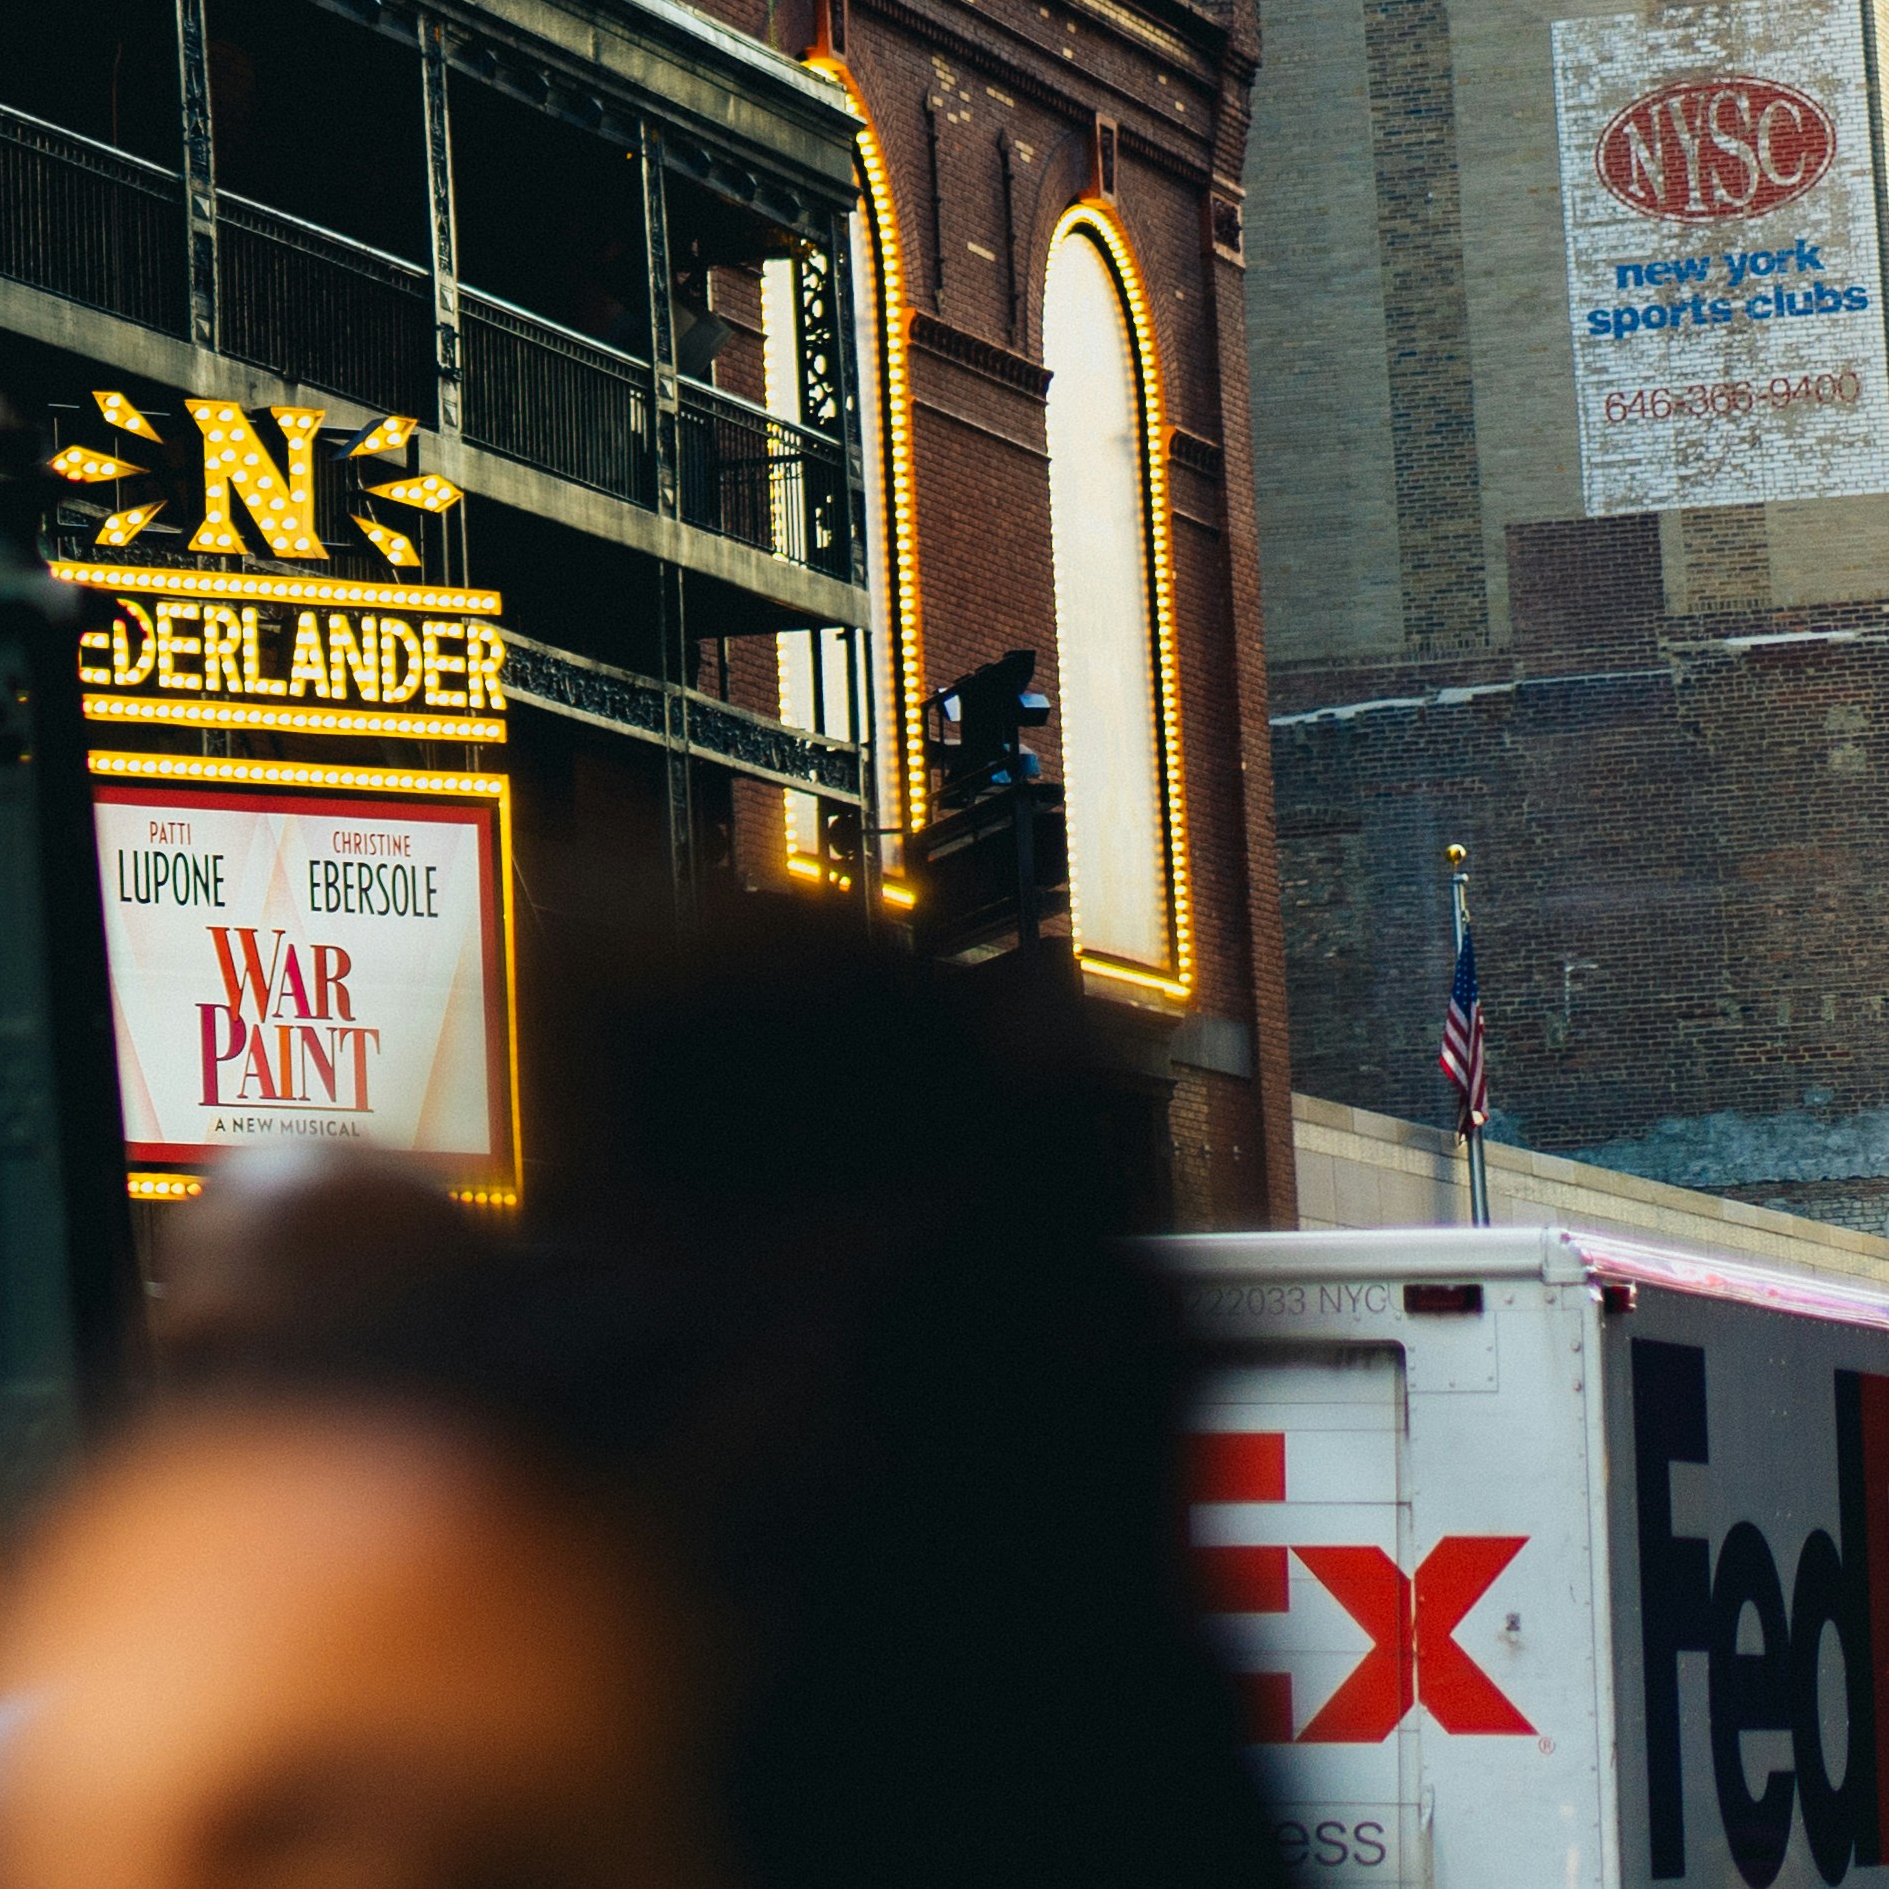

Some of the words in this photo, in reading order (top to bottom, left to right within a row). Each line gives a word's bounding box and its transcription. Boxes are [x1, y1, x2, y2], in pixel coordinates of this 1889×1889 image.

[1624, 90, 1807, 213] NYSC
[1616, 250, 1711, 290] new
[1725, 239, 1824, 281] york
[1587, 291, 1731, 340] sports
[1745, 281, 1870, 321] clubs
[184, 398, 329, 561] N
[149, 820, 191, 846] PATTI
[333, 830, 412, 857] CHRISTINE
[118, 849, 226, 908] LUPONE
[309, 859, 439, 918] EBERSOLE
[206, 925, 356, 1023] WAR
[195, 1002, 380, 1114] PAINT
[214, 1117, 226, 1132] A
[232, 1117, 274, 1135] NEW
[280, 1119, 360, 1137] MUSICAL
